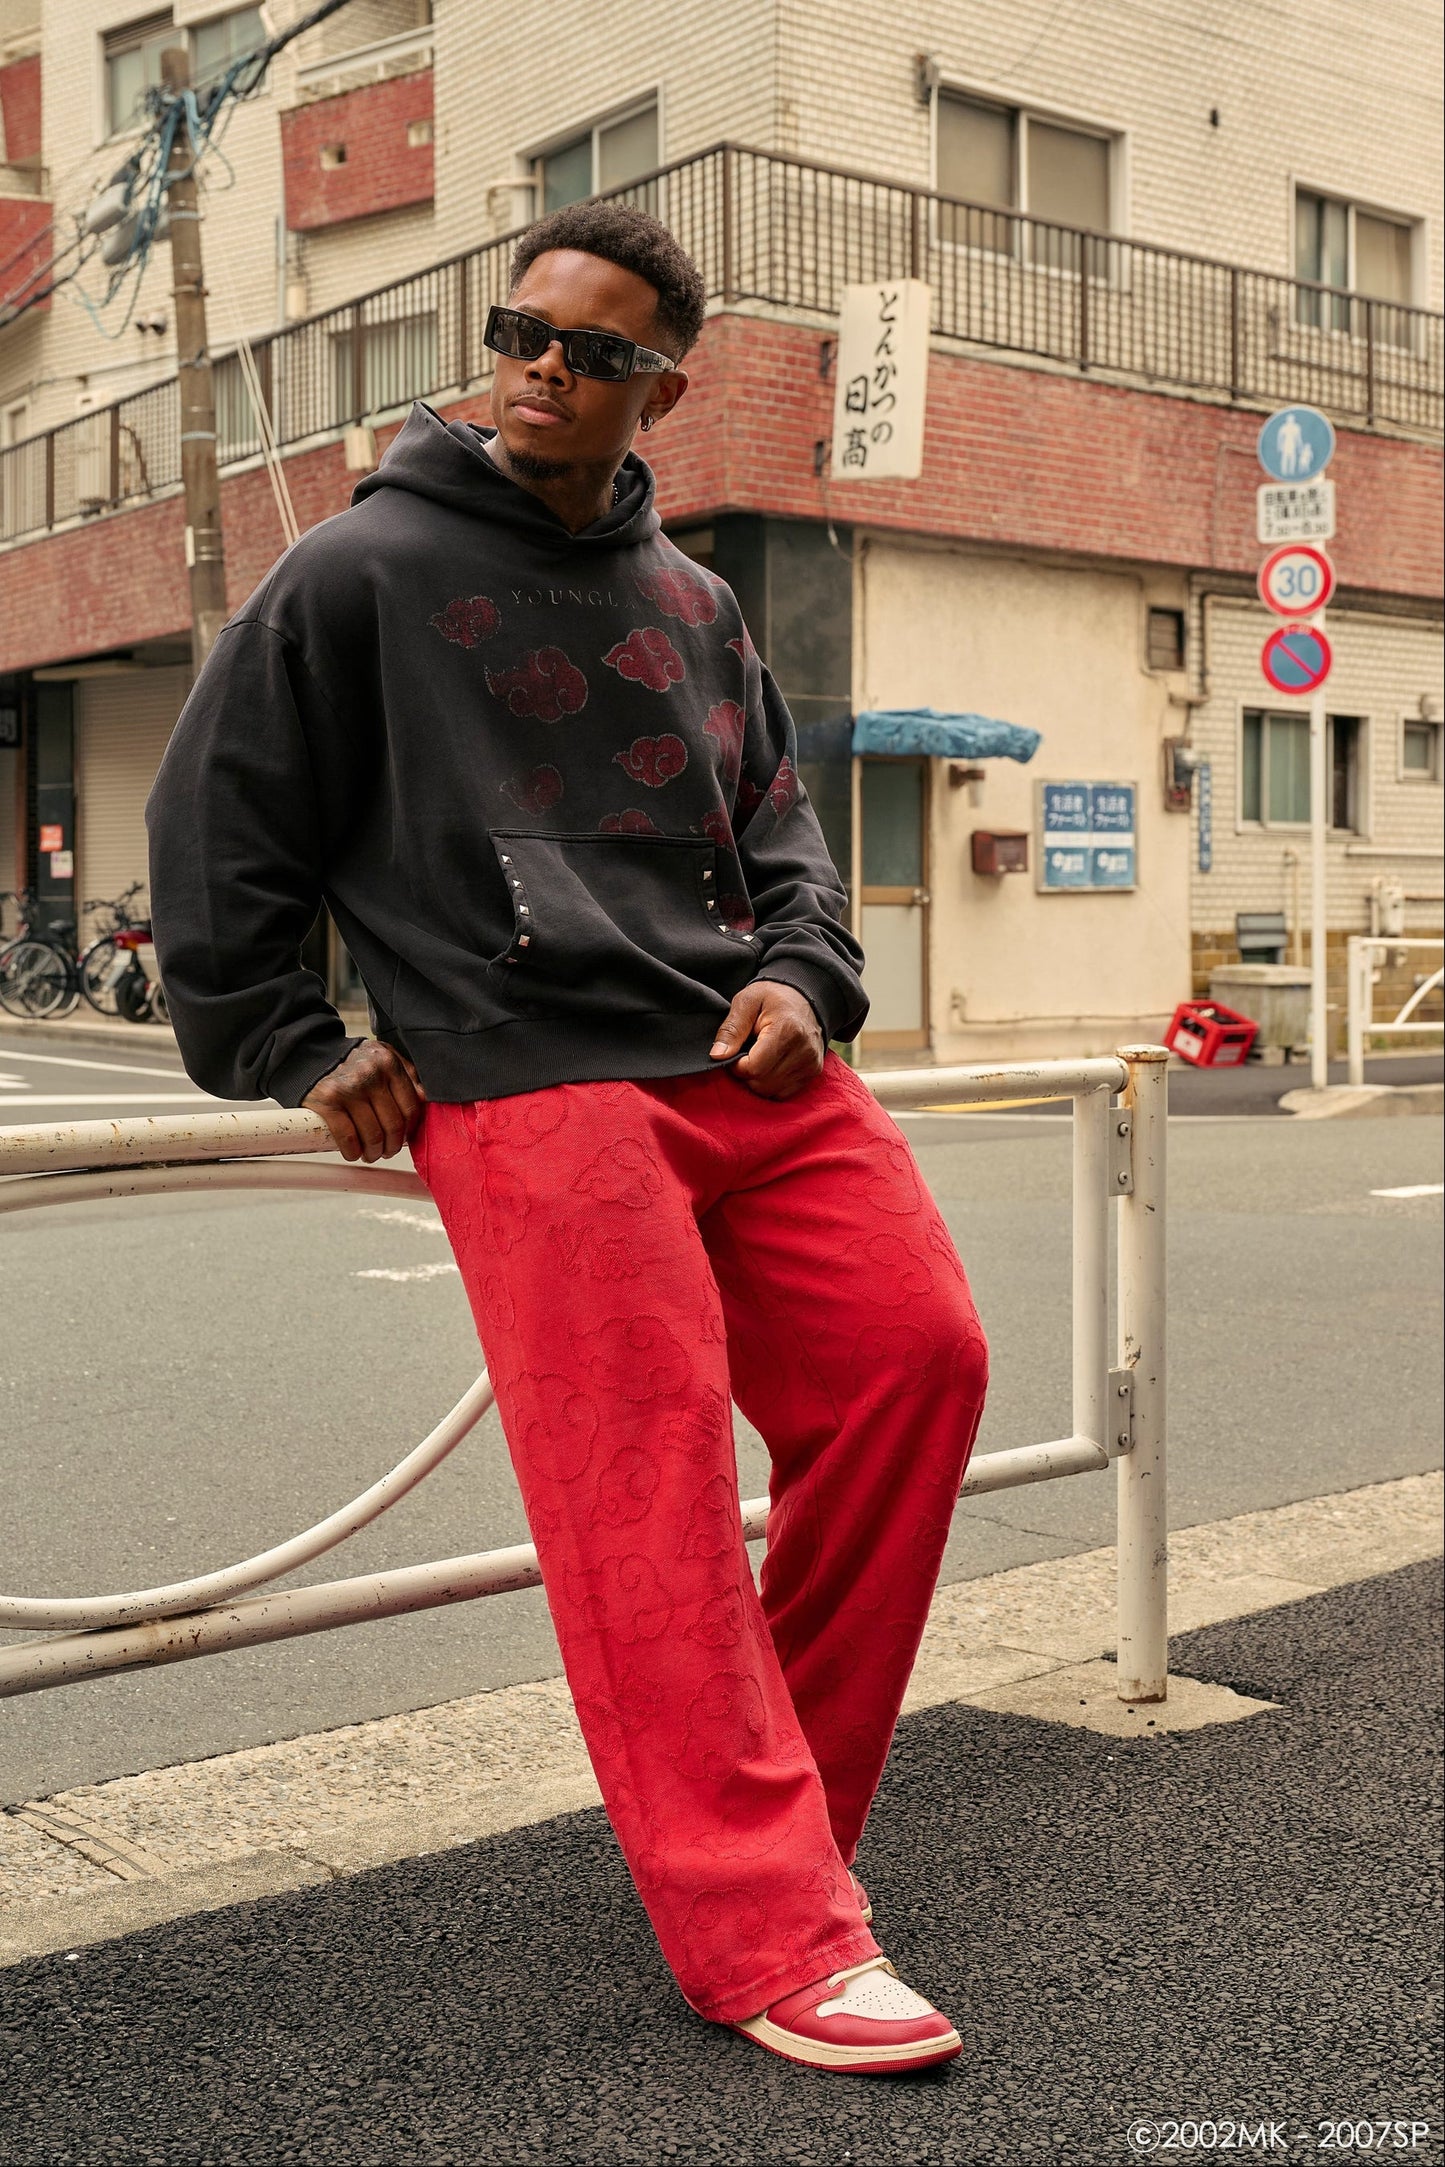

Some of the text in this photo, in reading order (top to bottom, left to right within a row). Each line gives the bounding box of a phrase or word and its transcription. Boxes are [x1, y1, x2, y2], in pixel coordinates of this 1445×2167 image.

[871, 290, 898, 444] とんかつの
[843, 375, 868, 468] 日高
[1277, 564, 1318, 598] 30
